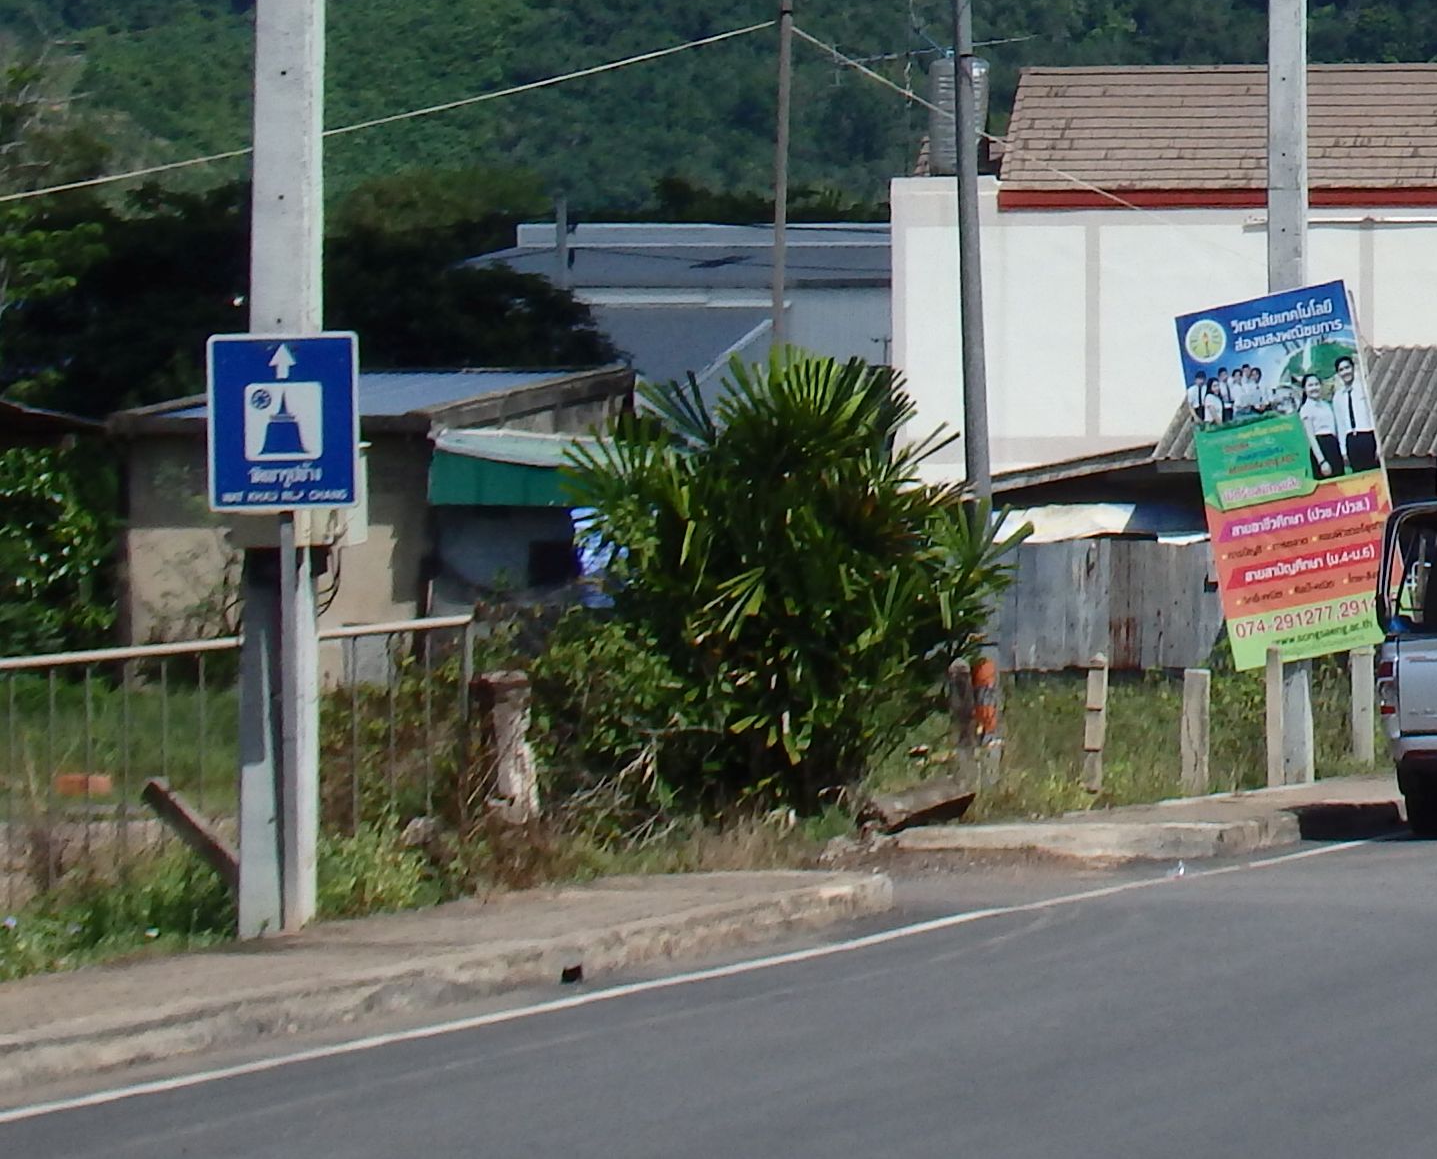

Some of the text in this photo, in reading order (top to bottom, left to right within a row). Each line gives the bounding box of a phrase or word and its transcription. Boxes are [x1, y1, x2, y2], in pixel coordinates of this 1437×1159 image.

[1230, 298, 1333, 334] วิทยาลัยเทคโนโลยี
